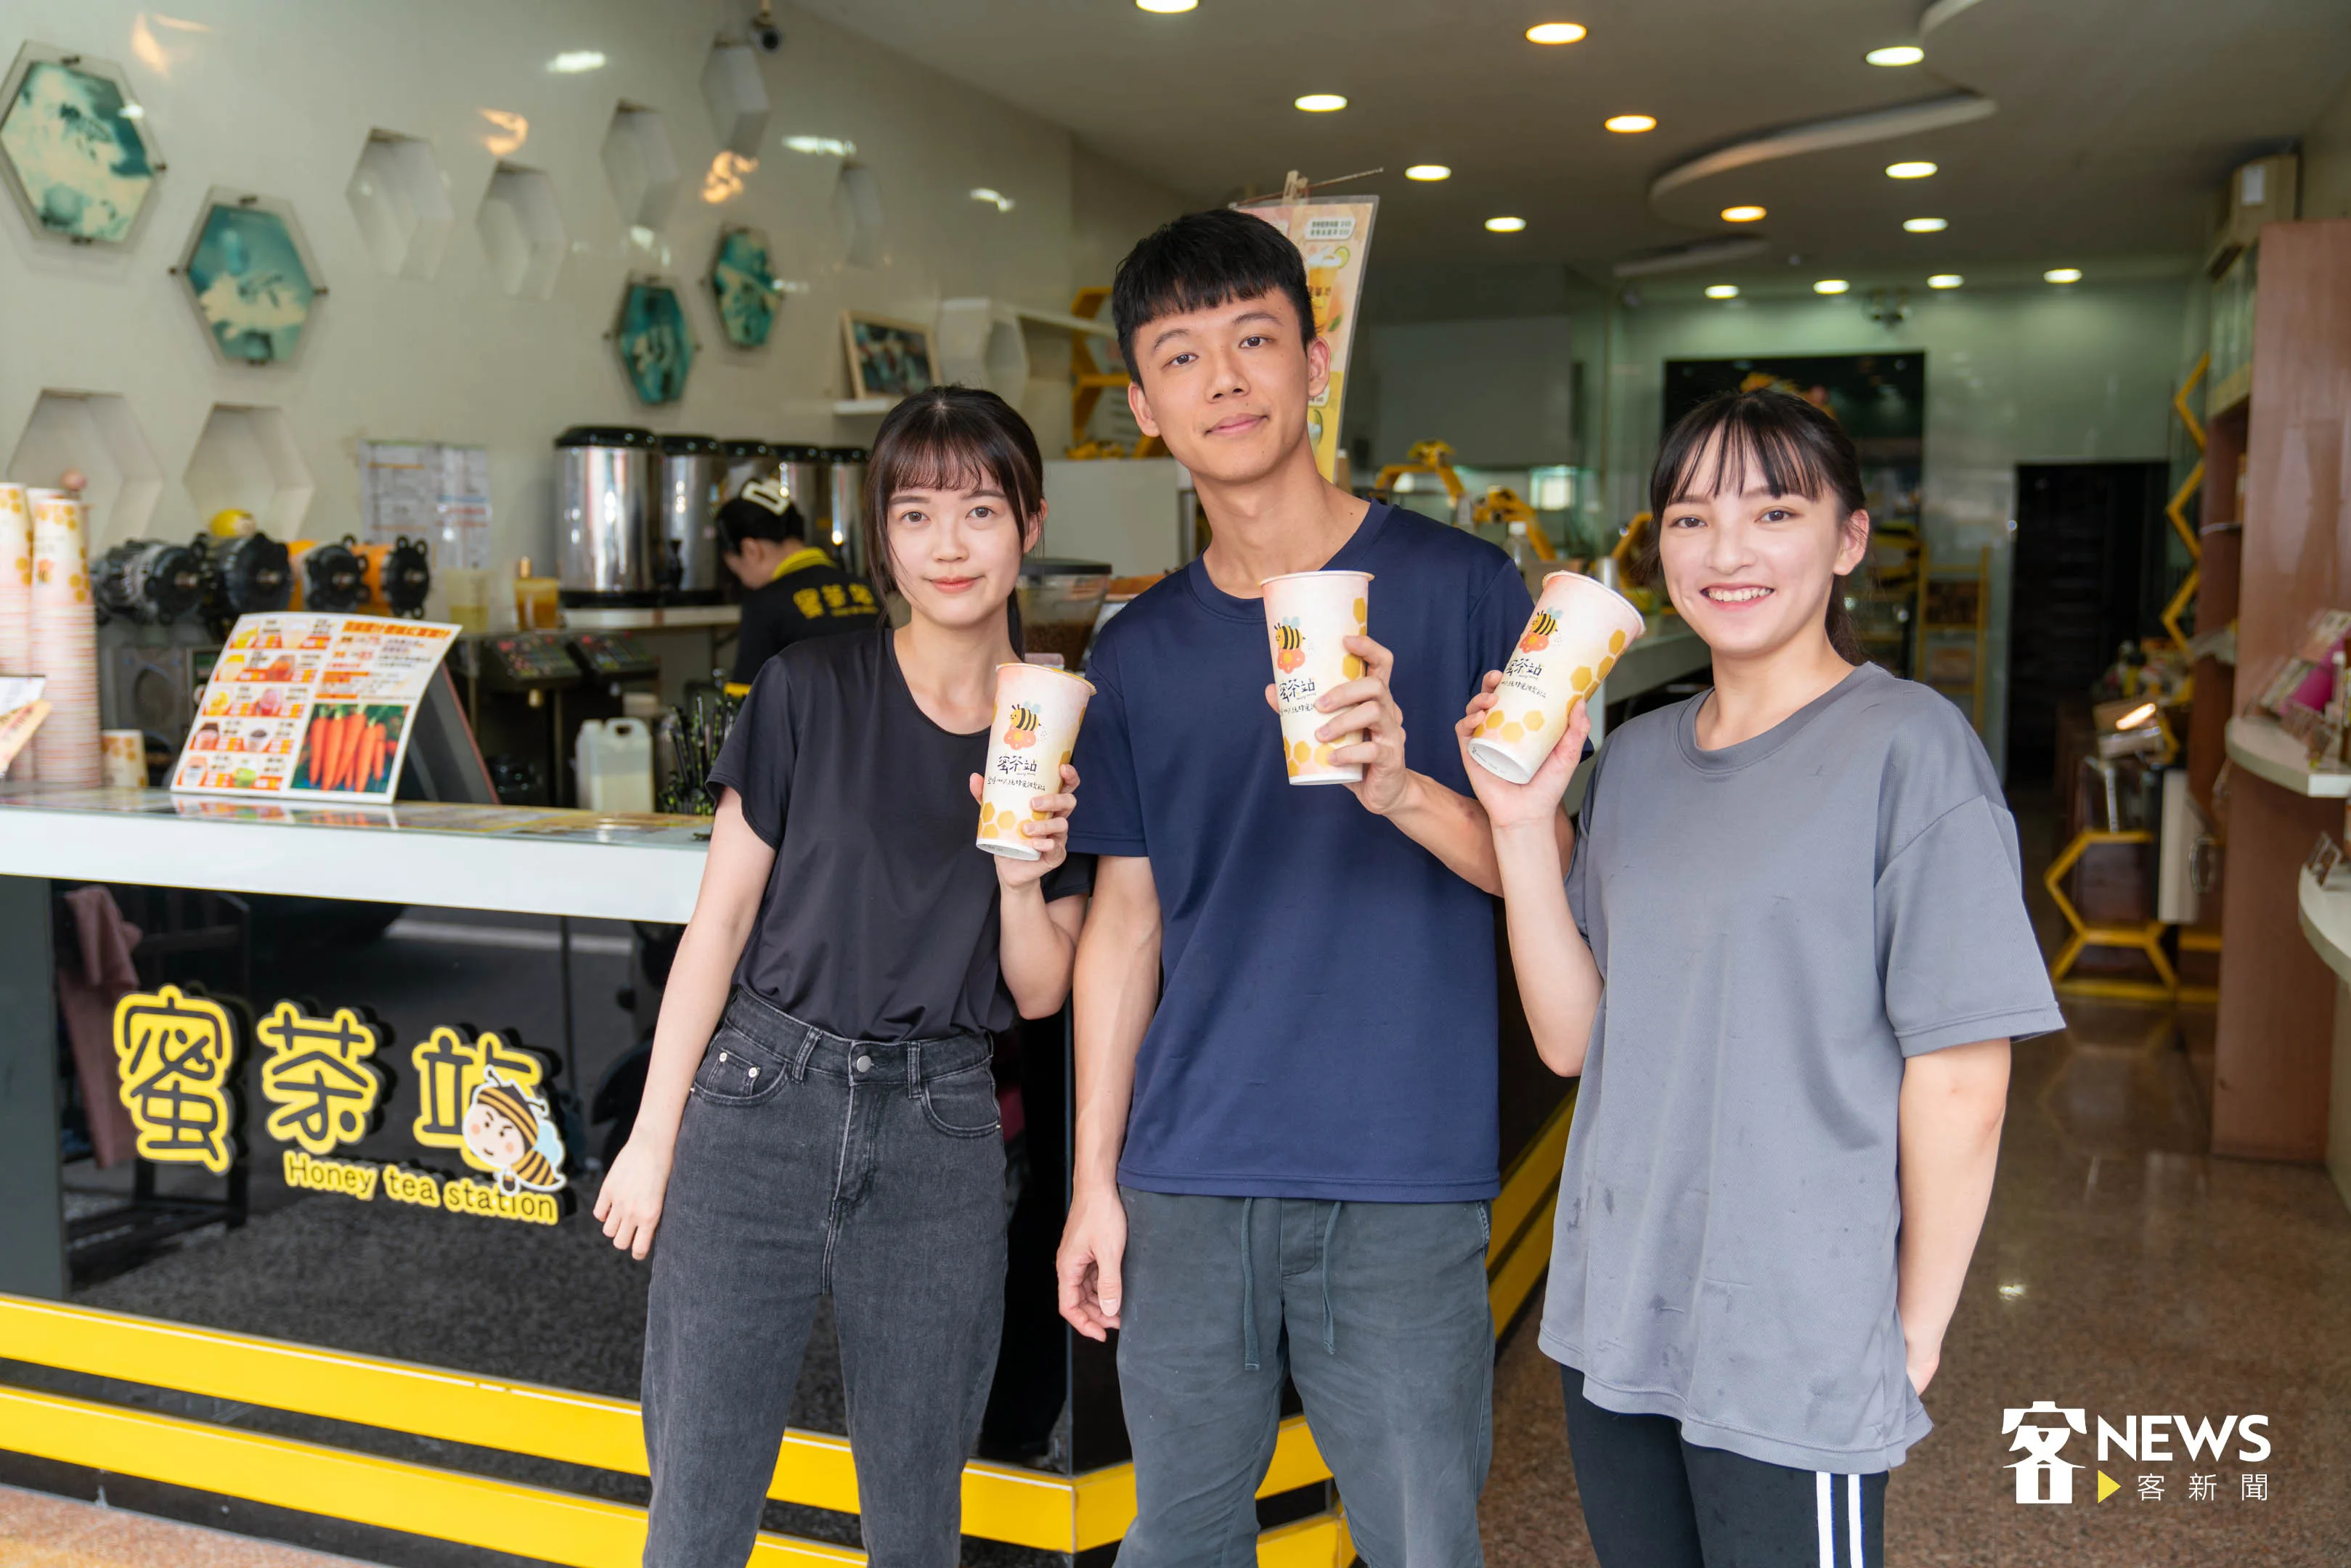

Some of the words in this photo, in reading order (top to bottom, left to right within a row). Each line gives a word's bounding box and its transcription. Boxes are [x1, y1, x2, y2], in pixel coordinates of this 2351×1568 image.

[1279, 678, 1315, 703] 蜜茶站
[997, 756, 1037, 775] 蜜茶站
[116, 986, 542, 1174] 蜜茶站
[285, 1151, 378, 1199] Honey
[385, 1165, 440, 1206] tea
[444, 1178, 557, 1224] station
